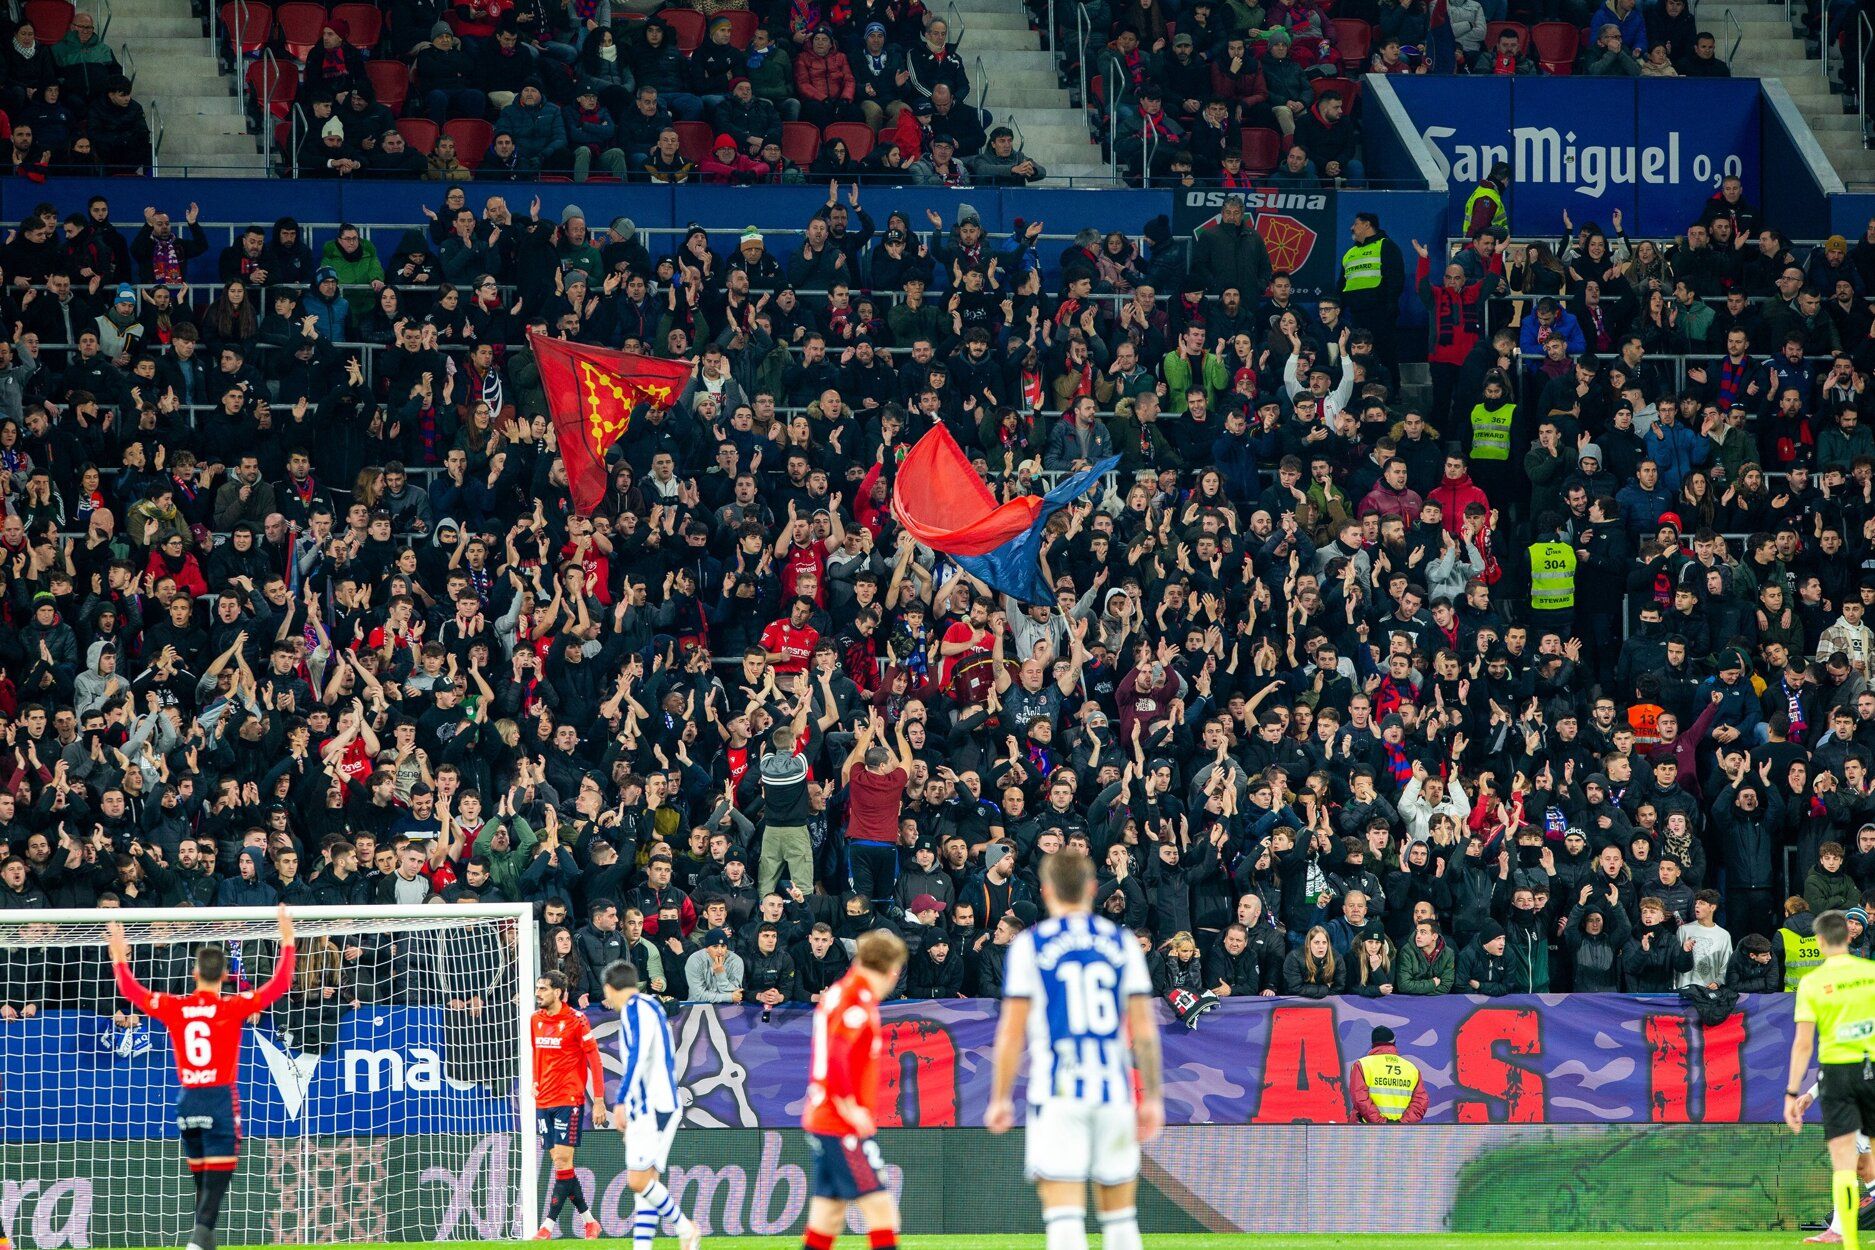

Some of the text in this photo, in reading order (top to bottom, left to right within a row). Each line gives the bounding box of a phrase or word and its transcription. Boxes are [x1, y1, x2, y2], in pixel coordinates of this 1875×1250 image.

[1422, 126, 1743, 198] San Miguel 0,0
[1491, 416, 1507, 424] 367
[1543, 560, 1567, 570] 304
[1539, 596, 1570, 604] STEWARD
[1640, 714, 1655, 725] 13
[1798, 948, 1820, 958] 339
[1056, 961, 1119, 1036] 16
[184, 1020, 212, 1067] 6
[1385, 1064, 1402, 1076] 75
[1374, 1077, 1412, 1088] SEGURIDAD
